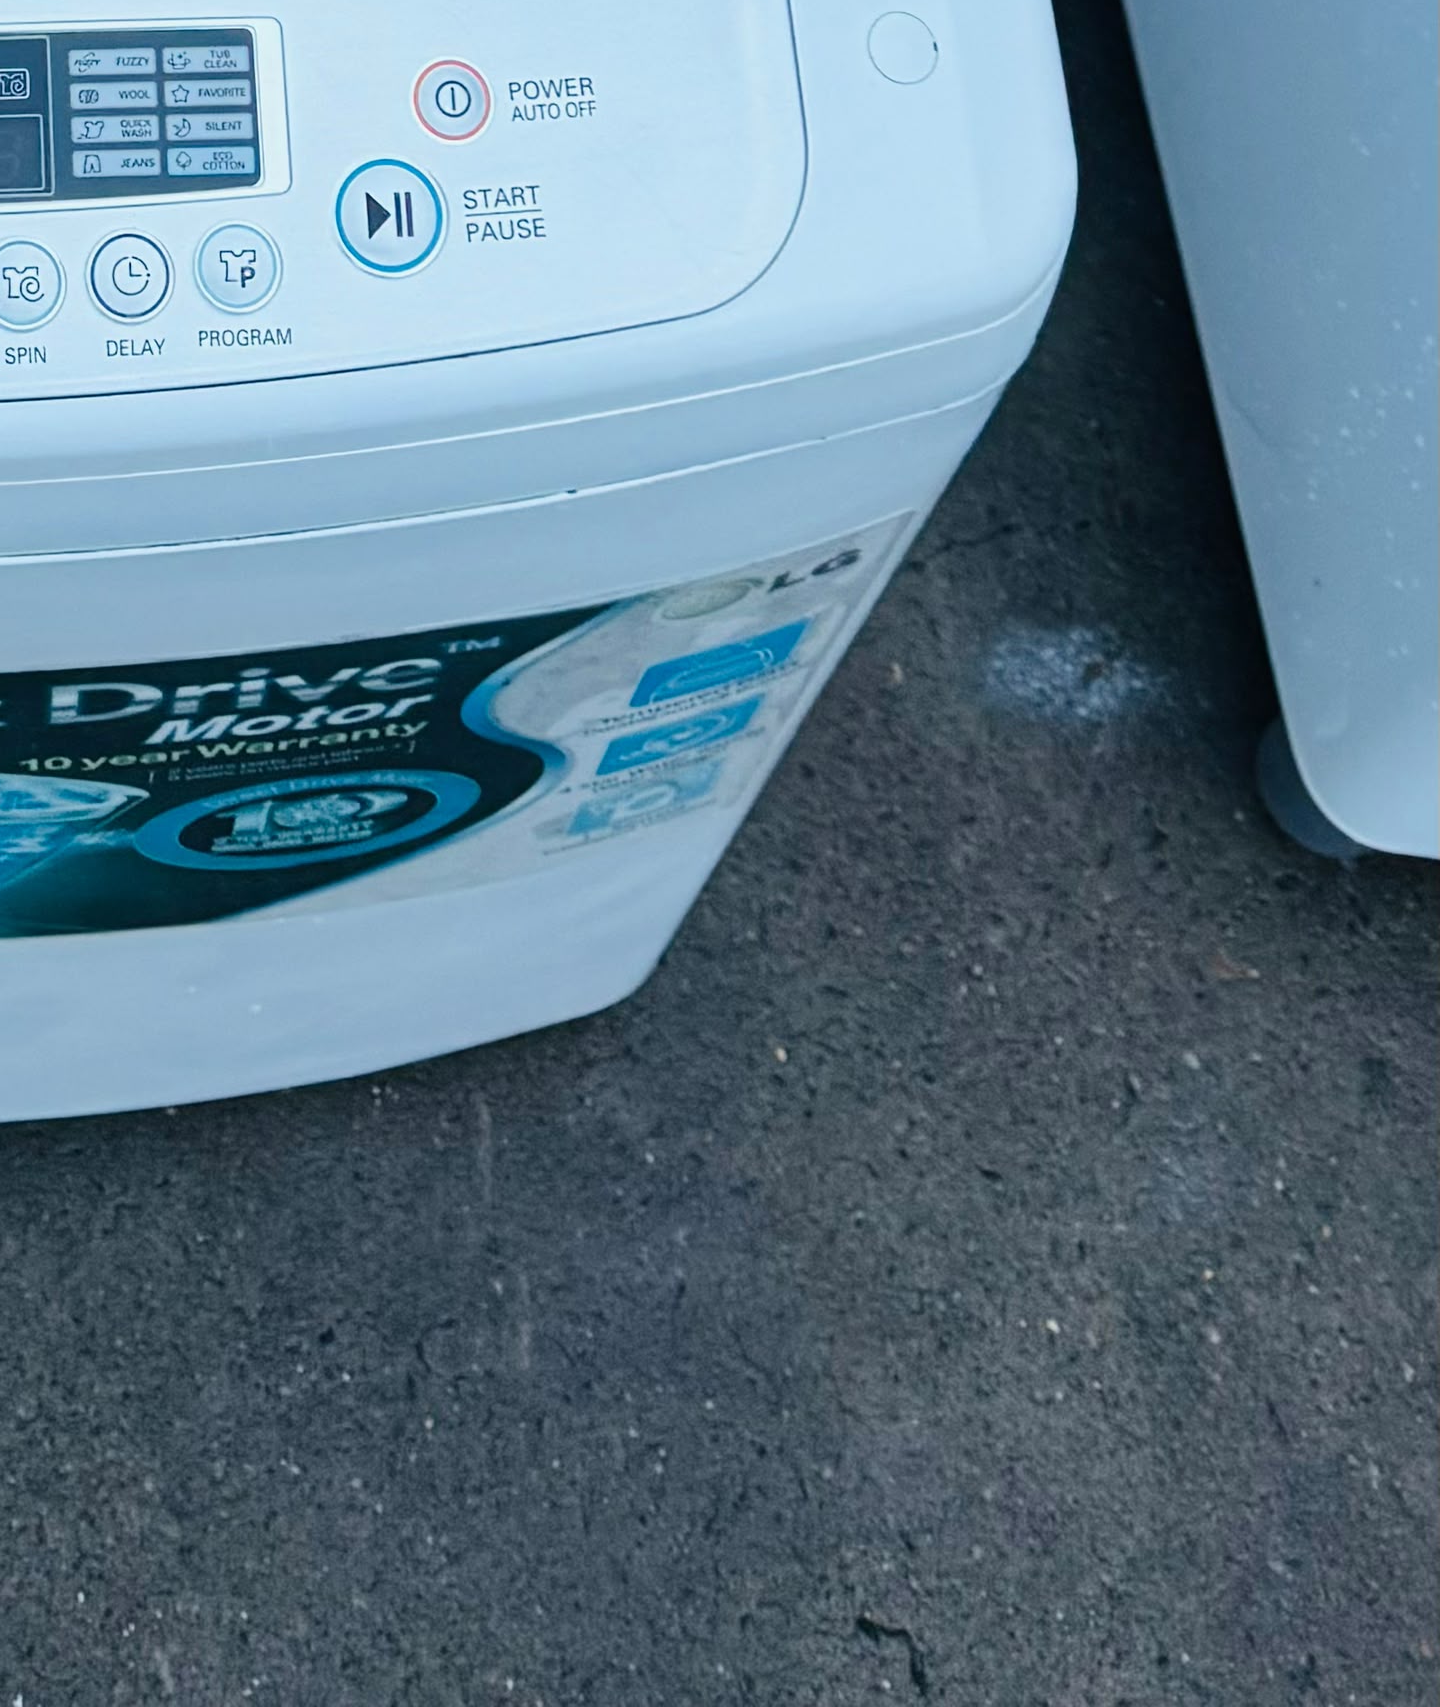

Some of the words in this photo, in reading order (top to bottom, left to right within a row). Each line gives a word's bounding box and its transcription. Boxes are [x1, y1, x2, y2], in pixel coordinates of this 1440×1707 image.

[119, 90, 151, 100] WOOL
[198, 87, 246, 98] FAVORITE
[508, 77, 594, 101] POWER
[512, 103, 561, 122] AUTO
[565, 100, 597, 119] OFF
[205, 120, 243, 131] SILENT
[463, 185, 540, 210] START
[466, 217, 547, 243] PAUSE
[106, 338, 166, 357] DELAY
[198, 328, 292, 346] PROGRAM
[5, 346, 47, 364] SPIN
[50, 657, 442, 725] Drive
[145, 693, 436, 745] Motor
[19, 756, 66, 772] 10
[80, 748, 191, 771] year
[195, 720, 429, 758] Warranty
